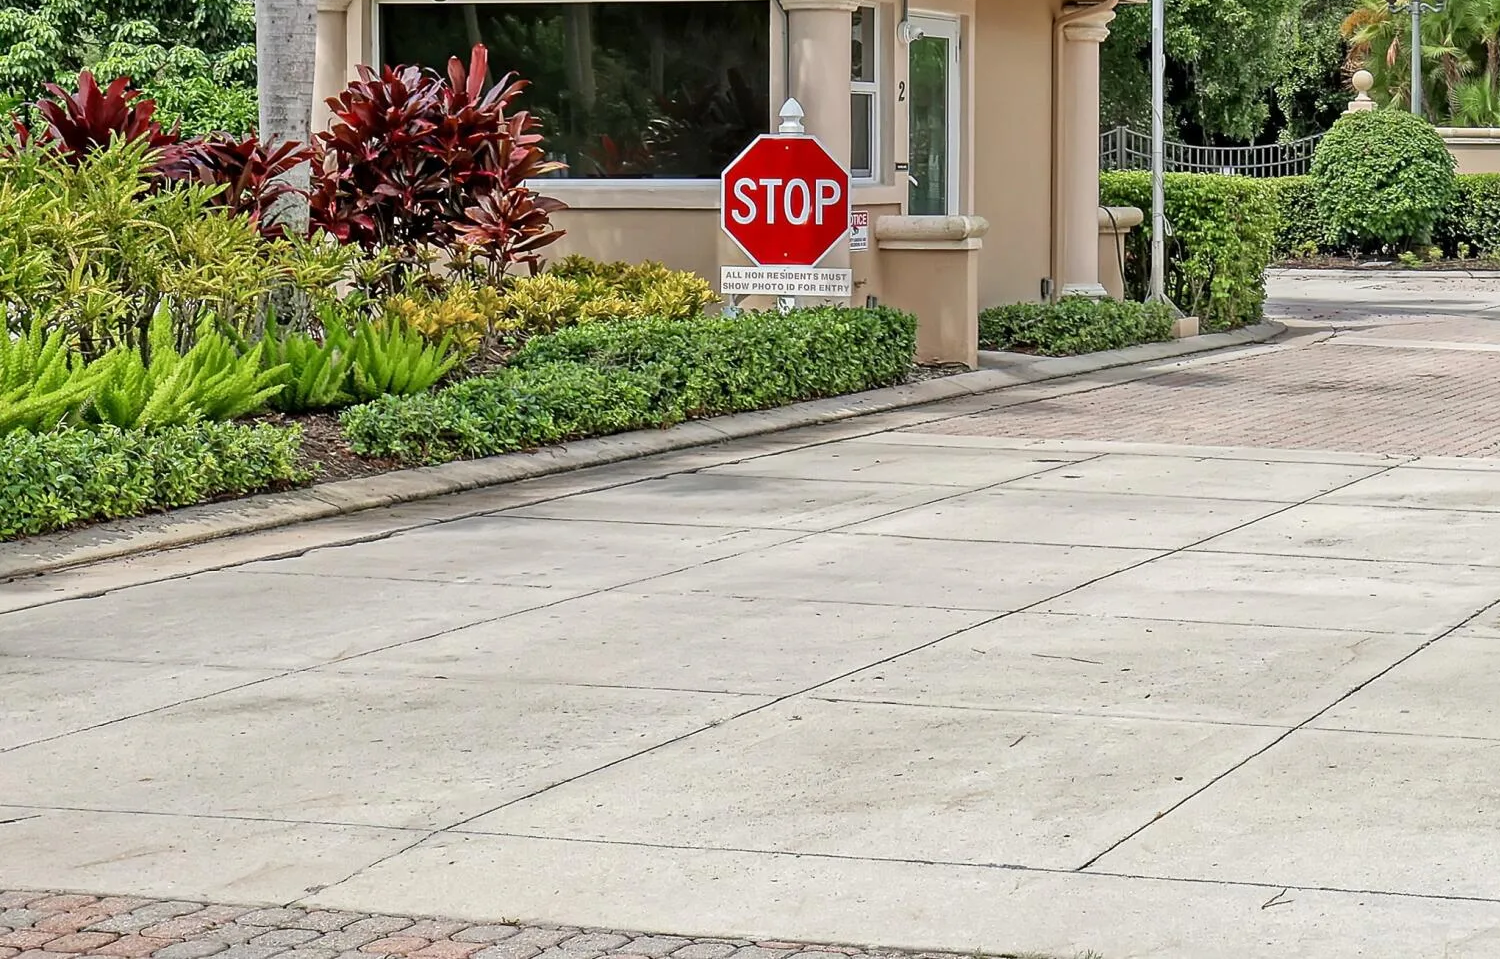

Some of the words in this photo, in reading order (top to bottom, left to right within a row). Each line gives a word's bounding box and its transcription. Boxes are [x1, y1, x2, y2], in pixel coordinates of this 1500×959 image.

[898, 80, 905, 102] 2
[731, 177, 841, 225] STOP
[725, 271, 742, 279] ALL
[744, 271, 764, 280] NON
[766, 271, 819, 281] RESIDENTS
[820, 273, 847, 281] MUST
[722, 282, 749, 290] SHOW
[752, 283, 784, 291] PHOTO
[786, 283, 796, 291] ID
[798, 284, 817, 292] FOR
[818, 284, 850, 293] ENTRY
